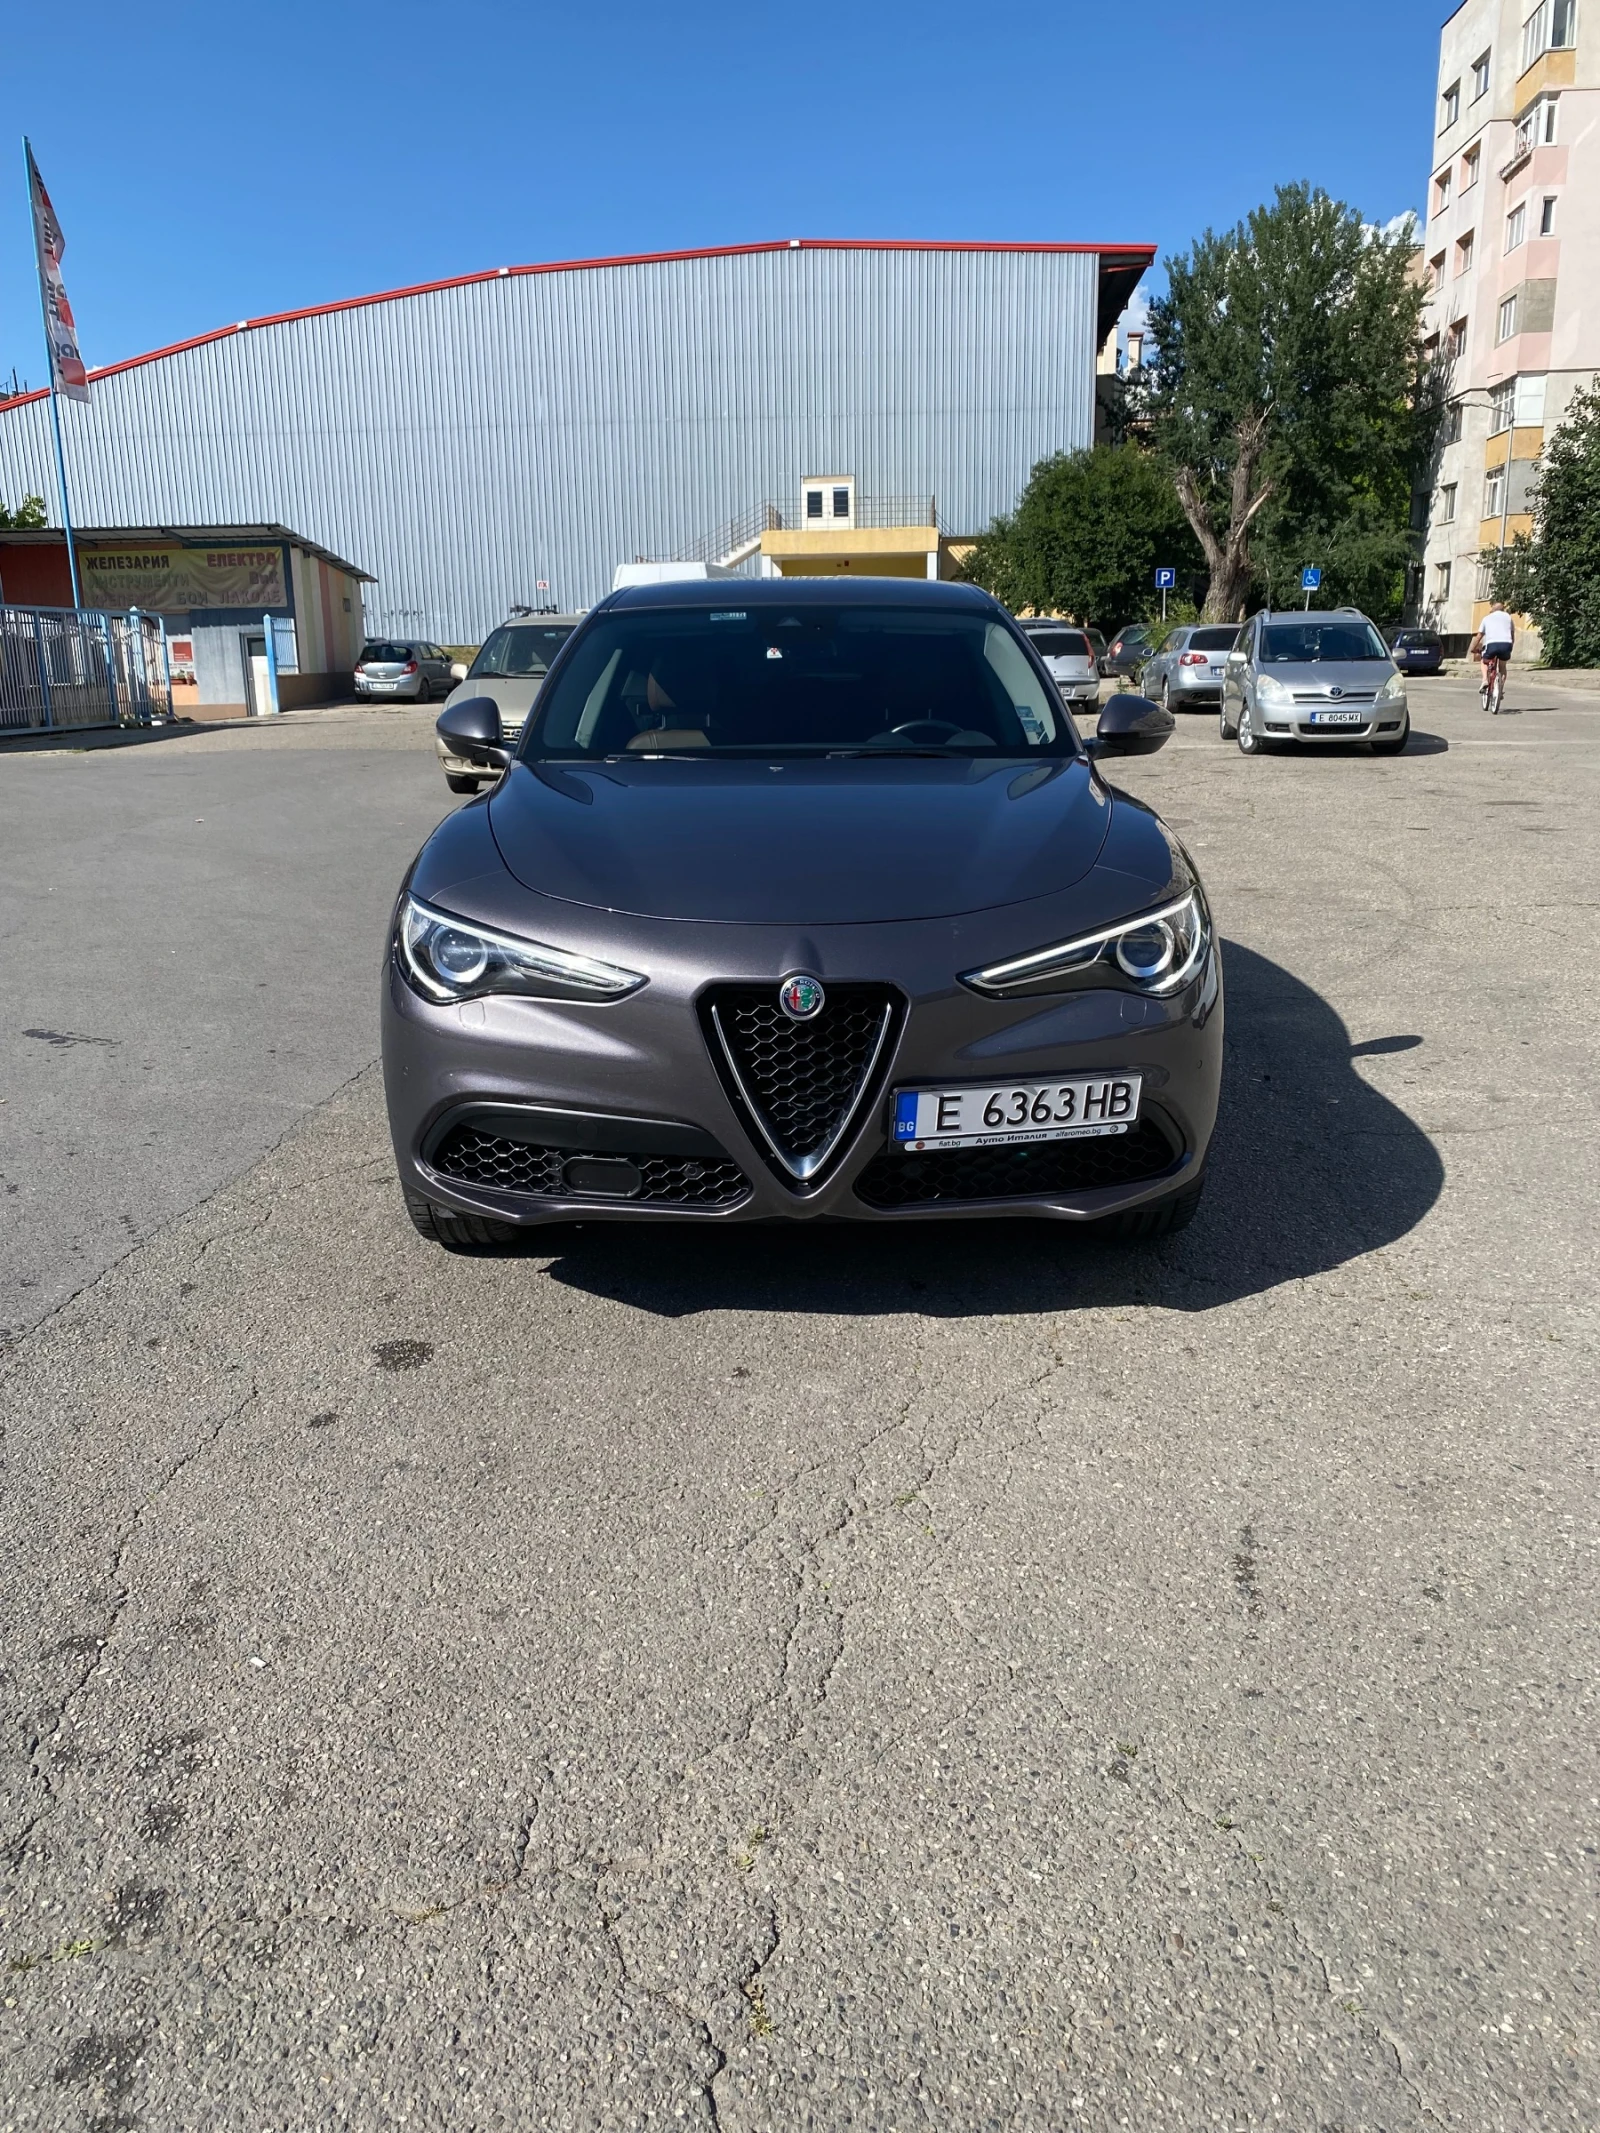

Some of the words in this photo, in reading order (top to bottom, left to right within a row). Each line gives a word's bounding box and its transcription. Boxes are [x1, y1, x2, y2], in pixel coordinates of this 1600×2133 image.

[86, 555, 170, 571] ЖЕЛЕЗАРИЯ
[207, 551, 276, 568] ЕЛЕКТРО
[88, 573, 190, 589] ИНСТРУМЕНТИ
[1161, 571, 1171, 585] P
[935, 1095, 962, 1132] E
[982, 1086, 1076, 1127] 6363
[1082, 1082, 1132, 1120] HB
[898, 1121, 915, 1133] BG
[1055, 1127, 1102, 1138] alfaromeo.bg
[938, 1139, 961, 1148] fiat.bg
[975, 1136, 1005, 1146] Ауто
[1006, 1132, 1048, 1143] Италия
